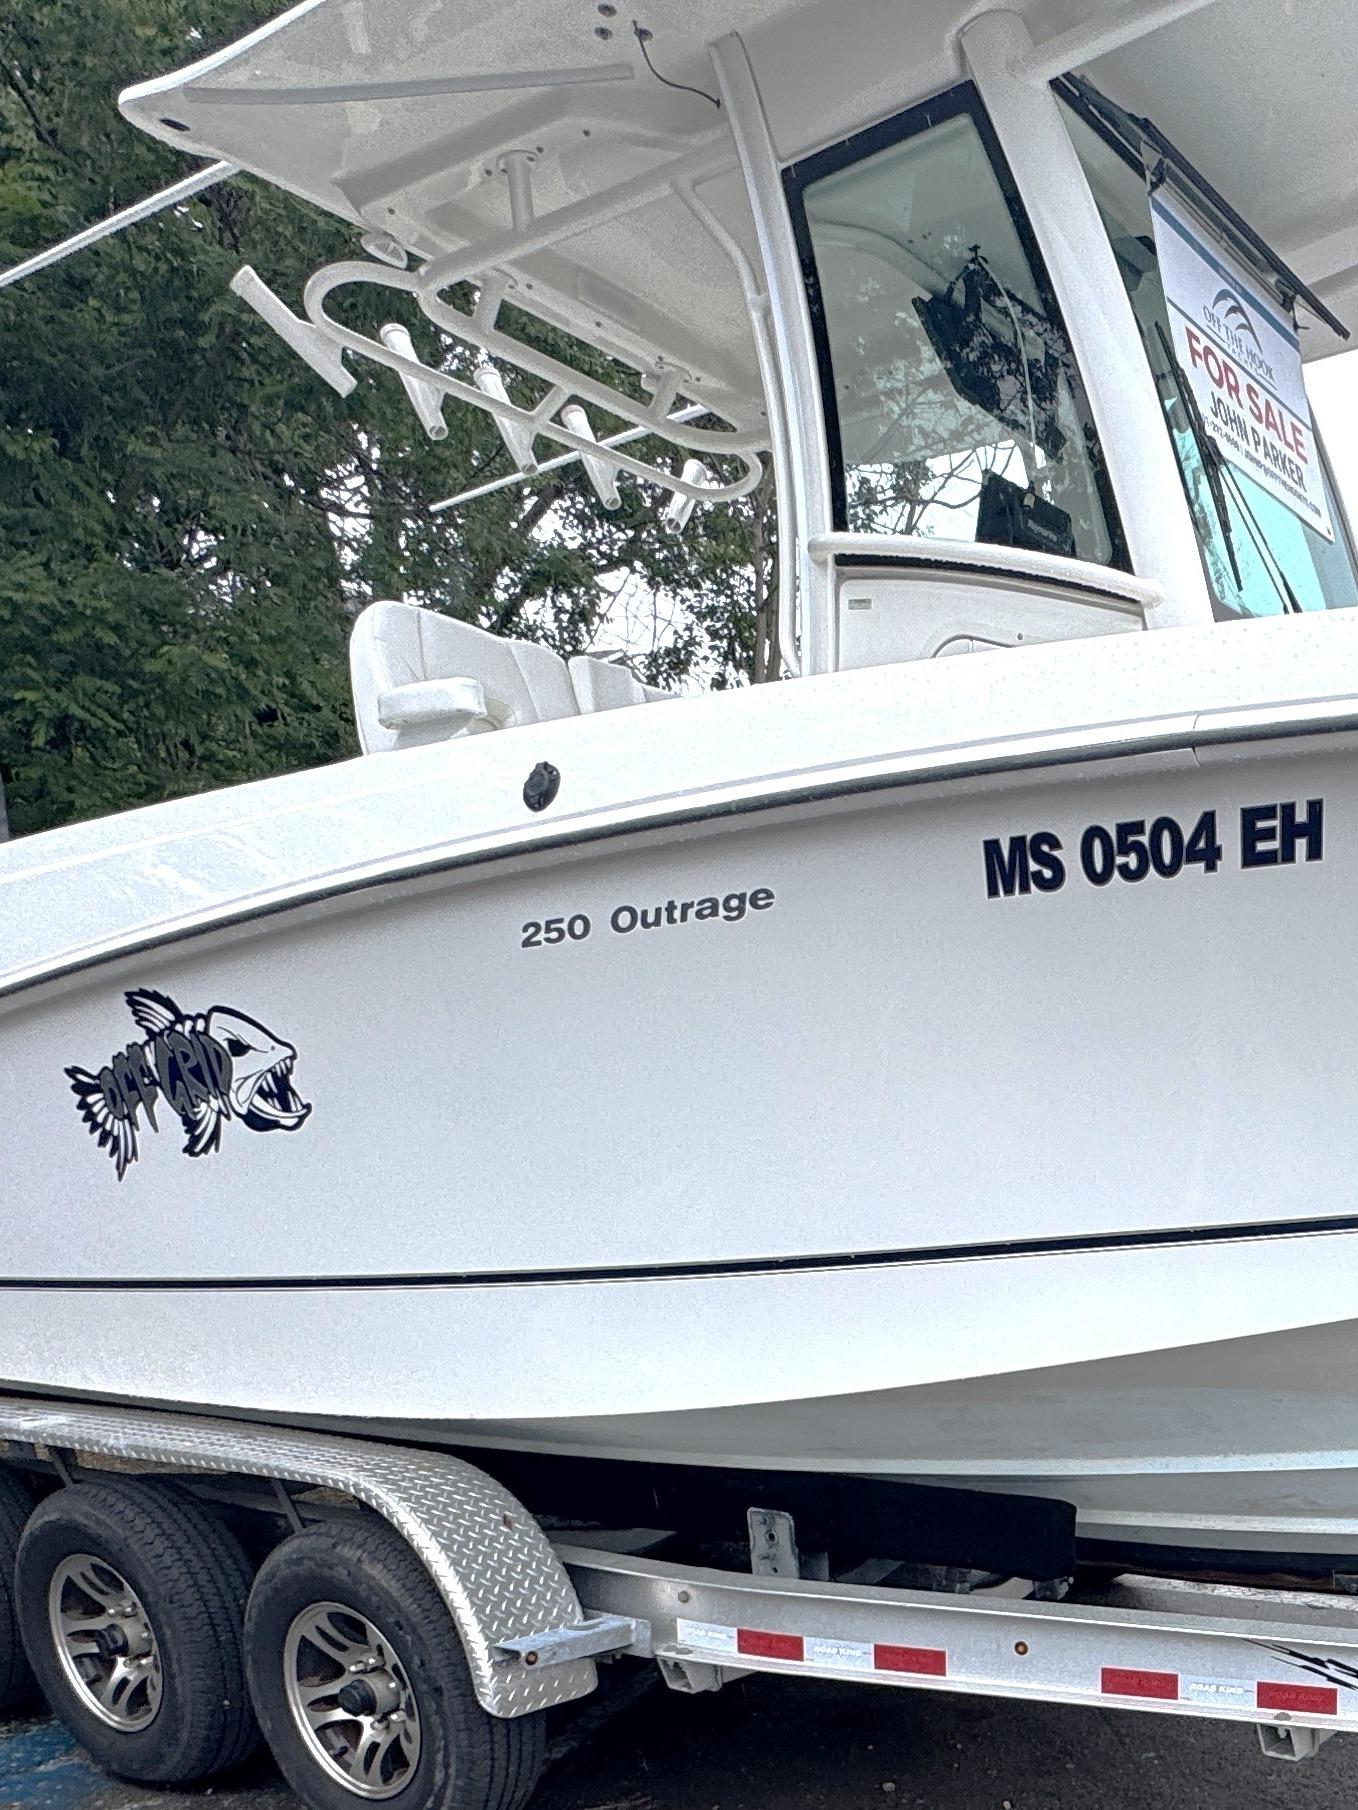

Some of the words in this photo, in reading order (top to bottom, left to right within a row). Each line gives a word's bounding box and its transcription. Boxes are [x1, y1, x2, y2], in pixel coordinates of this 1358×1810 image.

[1203, 305, 1221, 333] OFF
[1223, 322, 1244, 355] THE
[1245, 344, 1276, 382] HOOK
[1185, 326, 1243, 410] FOR
[1246, 383, 1308, 465] SALE
[1210, 391, 1250, 446] JOHN
[1251, 426, 1307, 493] PARKER
[982, 831, 1067, 899] MS
[1080, 809, 1223, 888] 0504
[1240, 798, 1324, 870] EH
[521, 914, 591, 948] 250
[611, 887, 775, 934] Outrage
